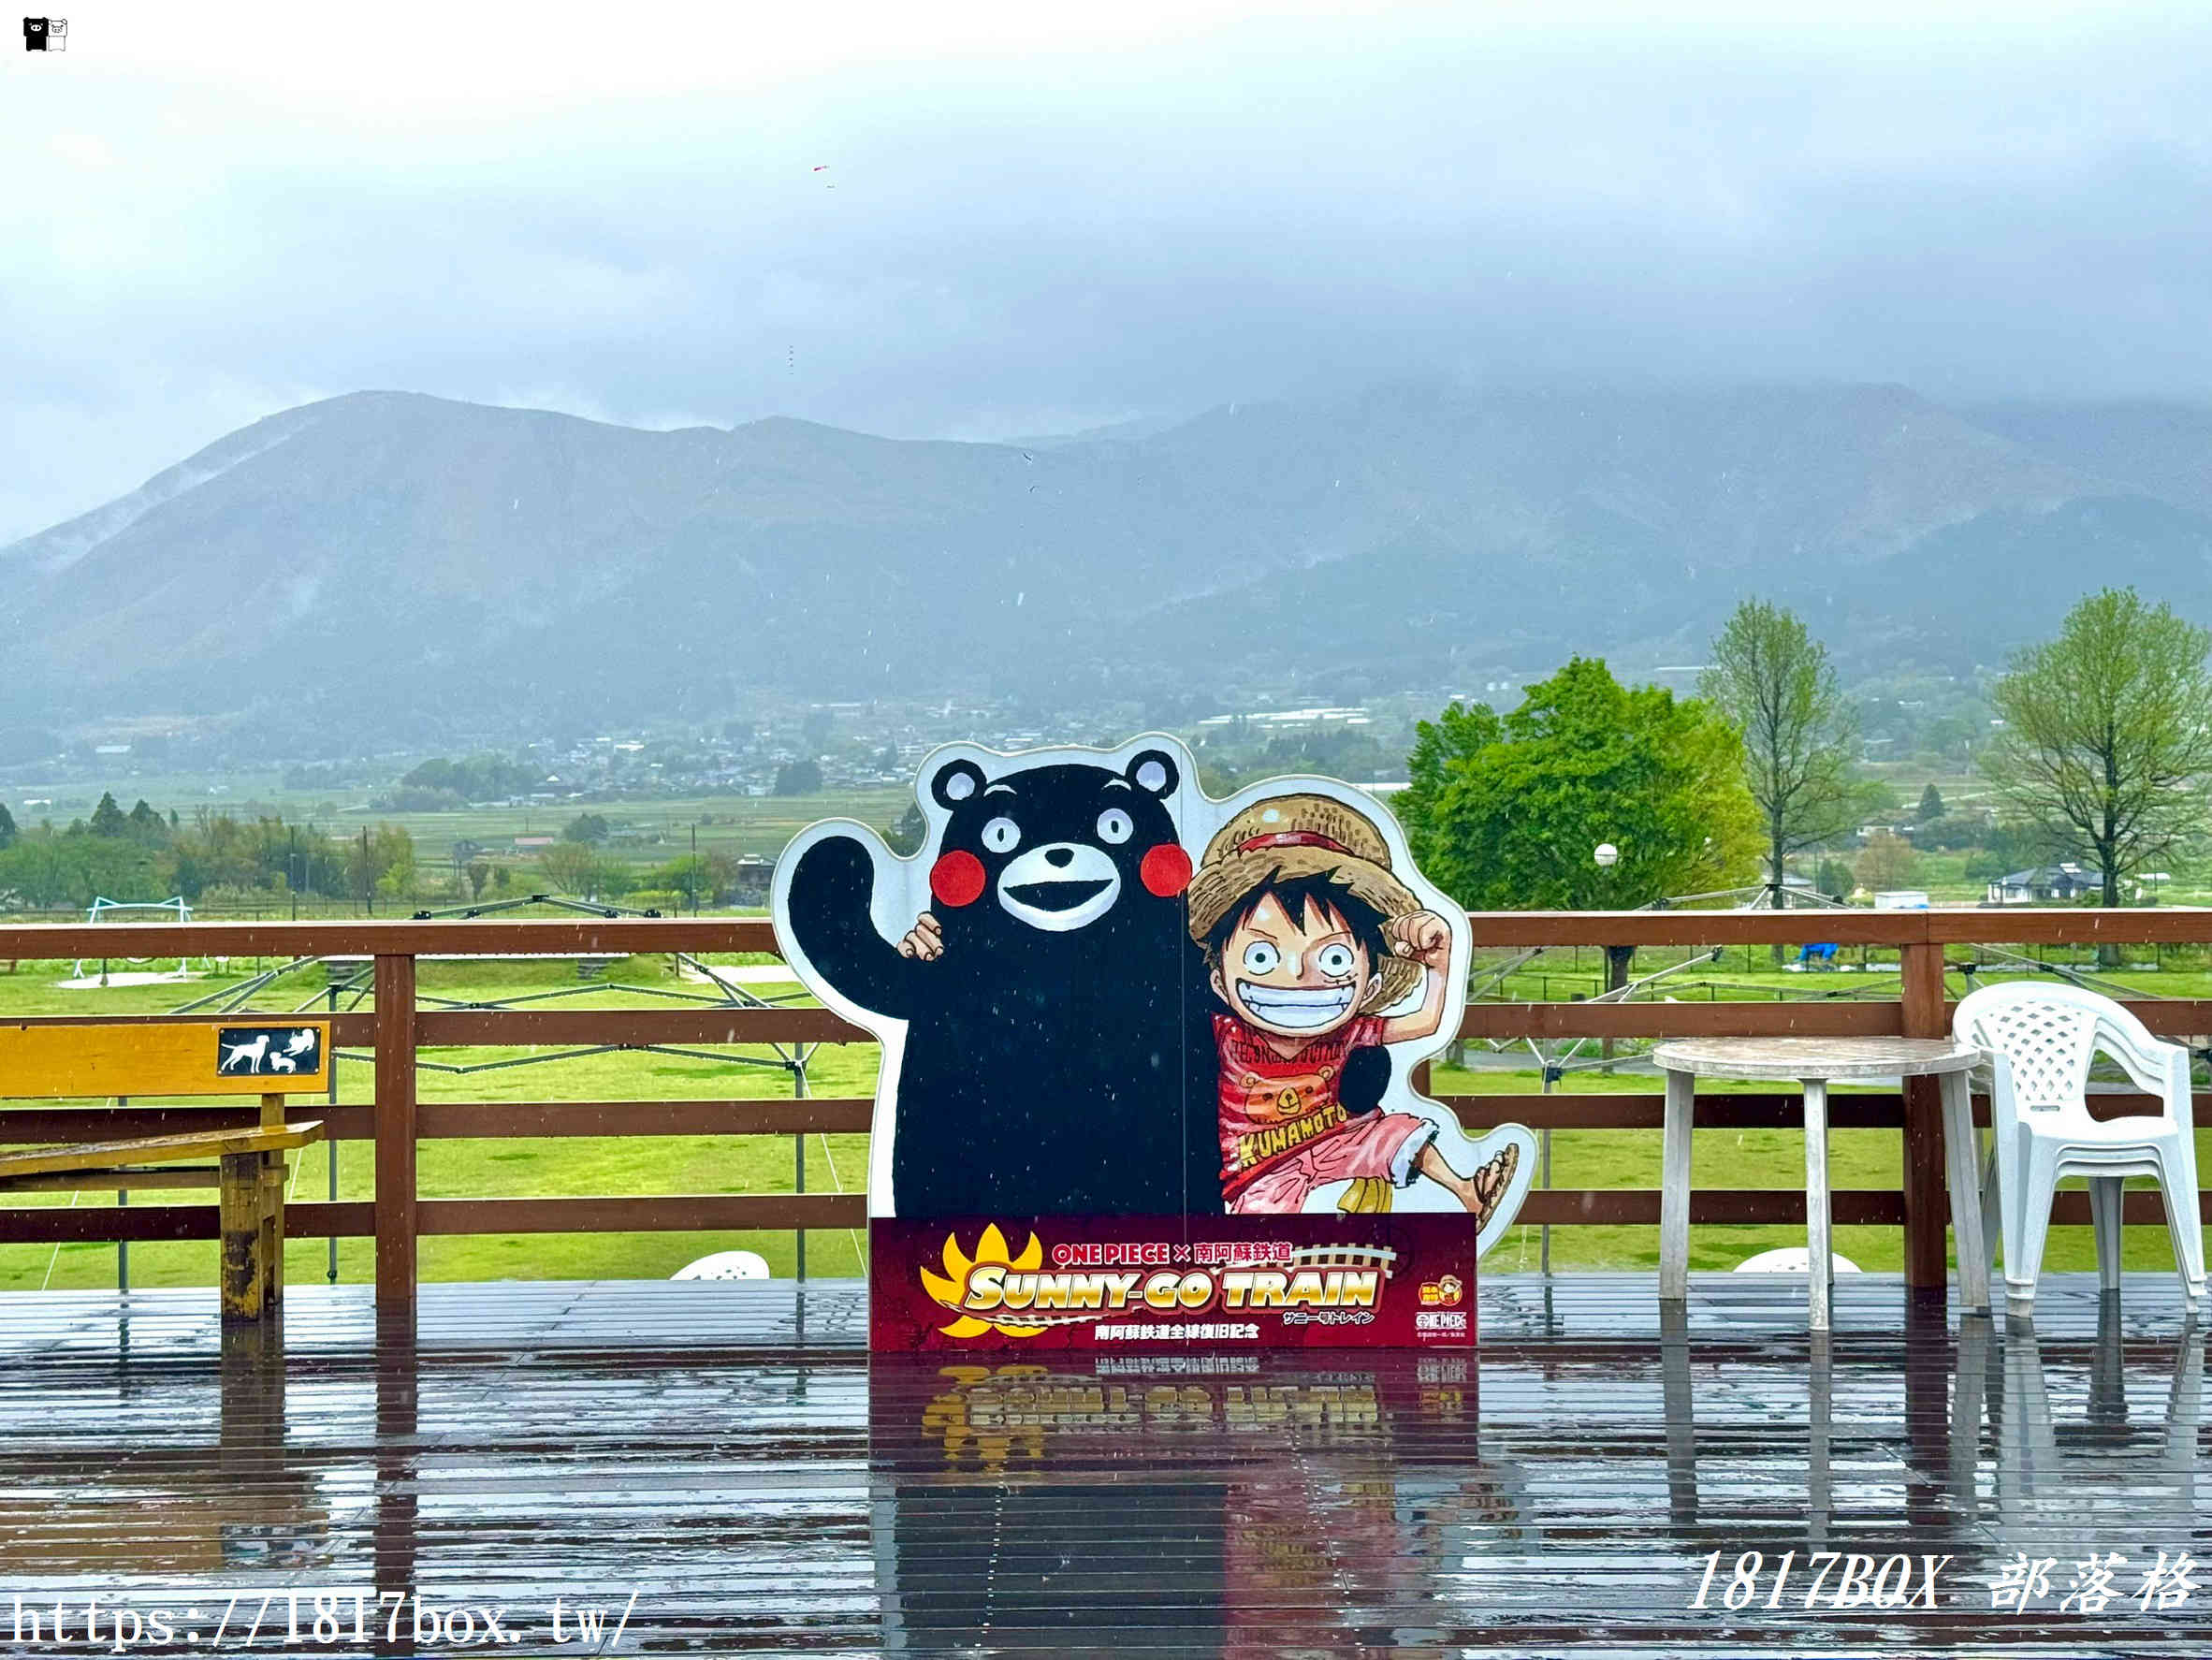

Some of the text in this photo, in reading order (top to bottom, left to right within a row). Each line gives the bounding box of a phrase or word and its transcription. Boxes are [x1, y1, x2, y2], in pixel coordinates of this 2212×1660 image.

[1238, 1102, 1347, 1168] KUMAMOTO
[1052, 1244, 1102, 1264] ONE
[1103, 1244, 1169, 1264] PIECE
[1193, 1242, 1293, 1262] 南阿蘇鉄道
[964, 1267, 1214, 1309] SUNNY-GO
[1221, 1271, 1375, 1307] TRAIN
